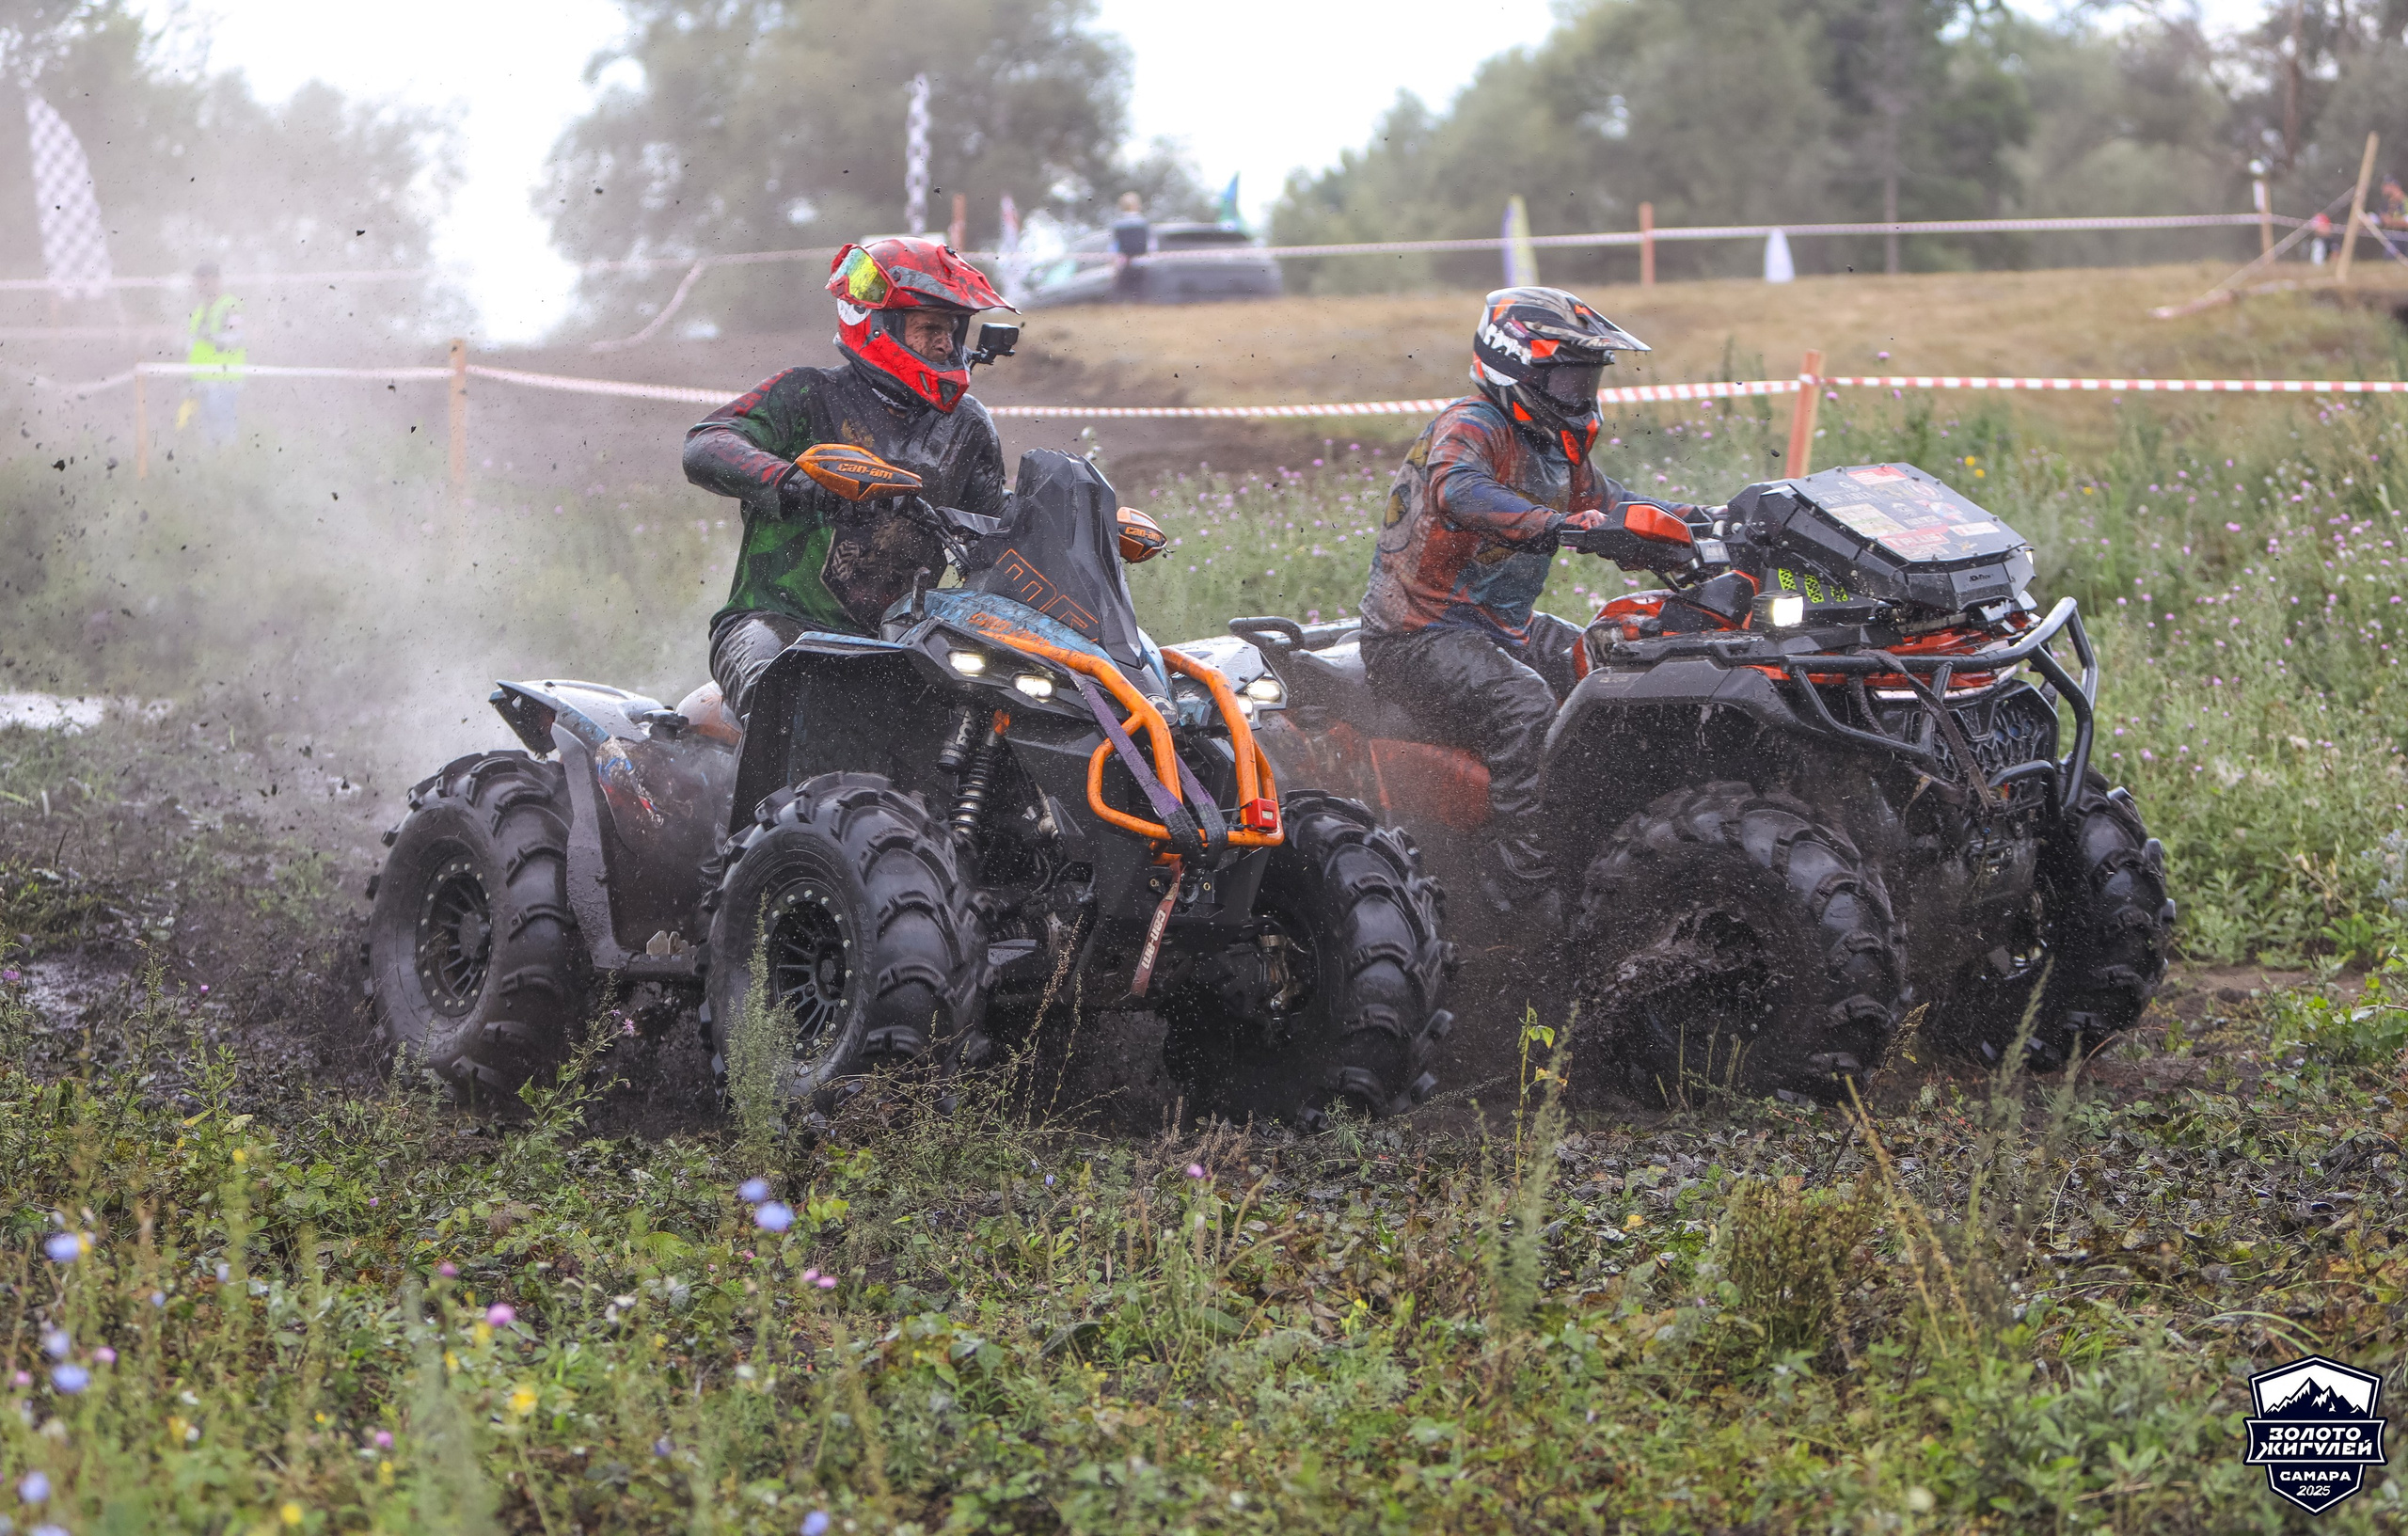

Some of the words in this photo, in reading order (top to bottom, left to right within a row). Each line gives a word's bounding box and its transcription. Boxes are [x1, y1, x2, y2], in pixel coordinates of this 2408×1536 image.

[837, 463, 894, 480] can-am
[1124, 527, 1161, 543] can-am
[1141, 909, 1166, 970] can-am
